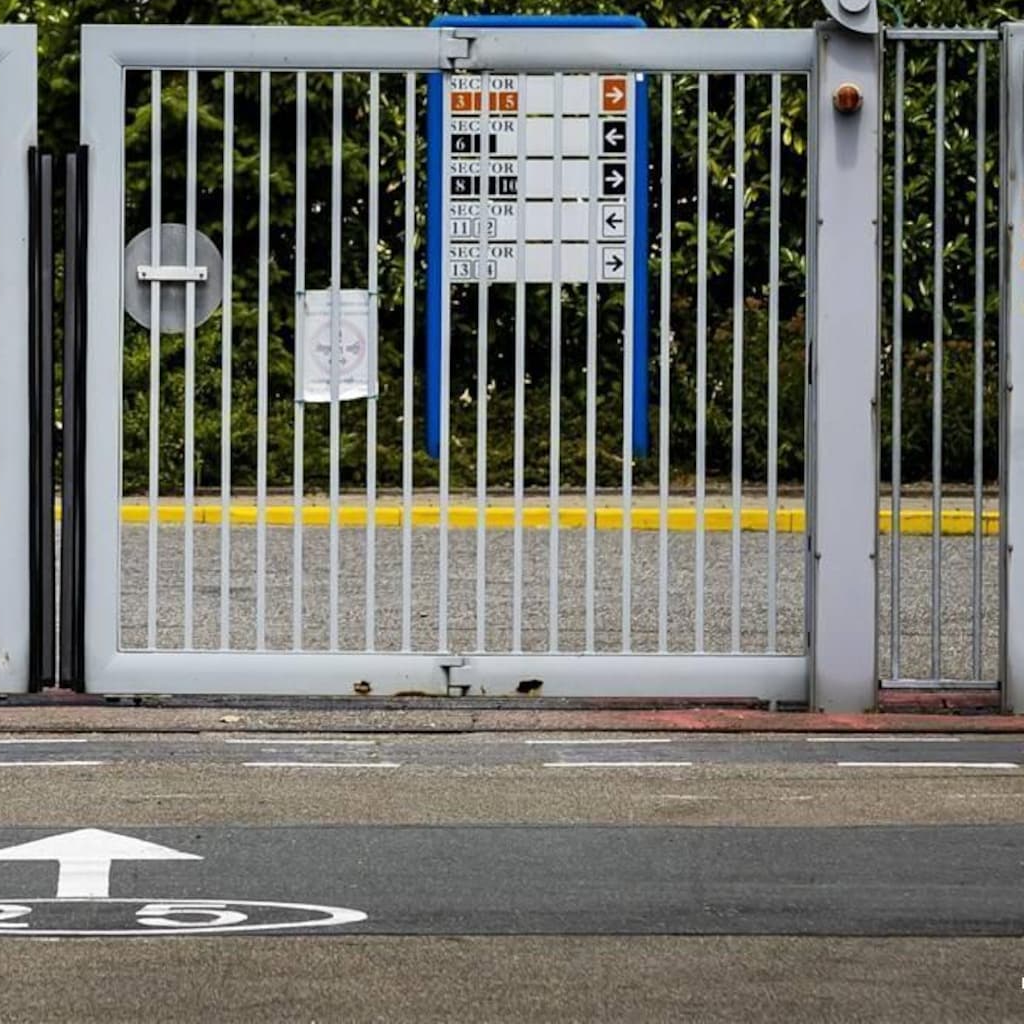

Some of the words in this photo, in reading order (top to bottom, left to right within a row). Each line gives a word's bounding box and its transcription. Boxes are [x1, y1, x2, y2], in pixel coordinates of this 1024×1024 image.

[449, 78, 514, 90] SECOR
[455, 94, 465, 110] 3
[505, 94, 515, 110] 5
[449, 120, 514, 132] SECOR
[455, 136, 466, 151] 6
[449, 162, 514, 174] SECOR
[454, 178, 466, 193] 8
[449, 204, 514, 216] SECOR
[452, 221, 467, 235] 11
[449, 246, 514, 258] SECOR
[452, 263, 469, 277] 13
